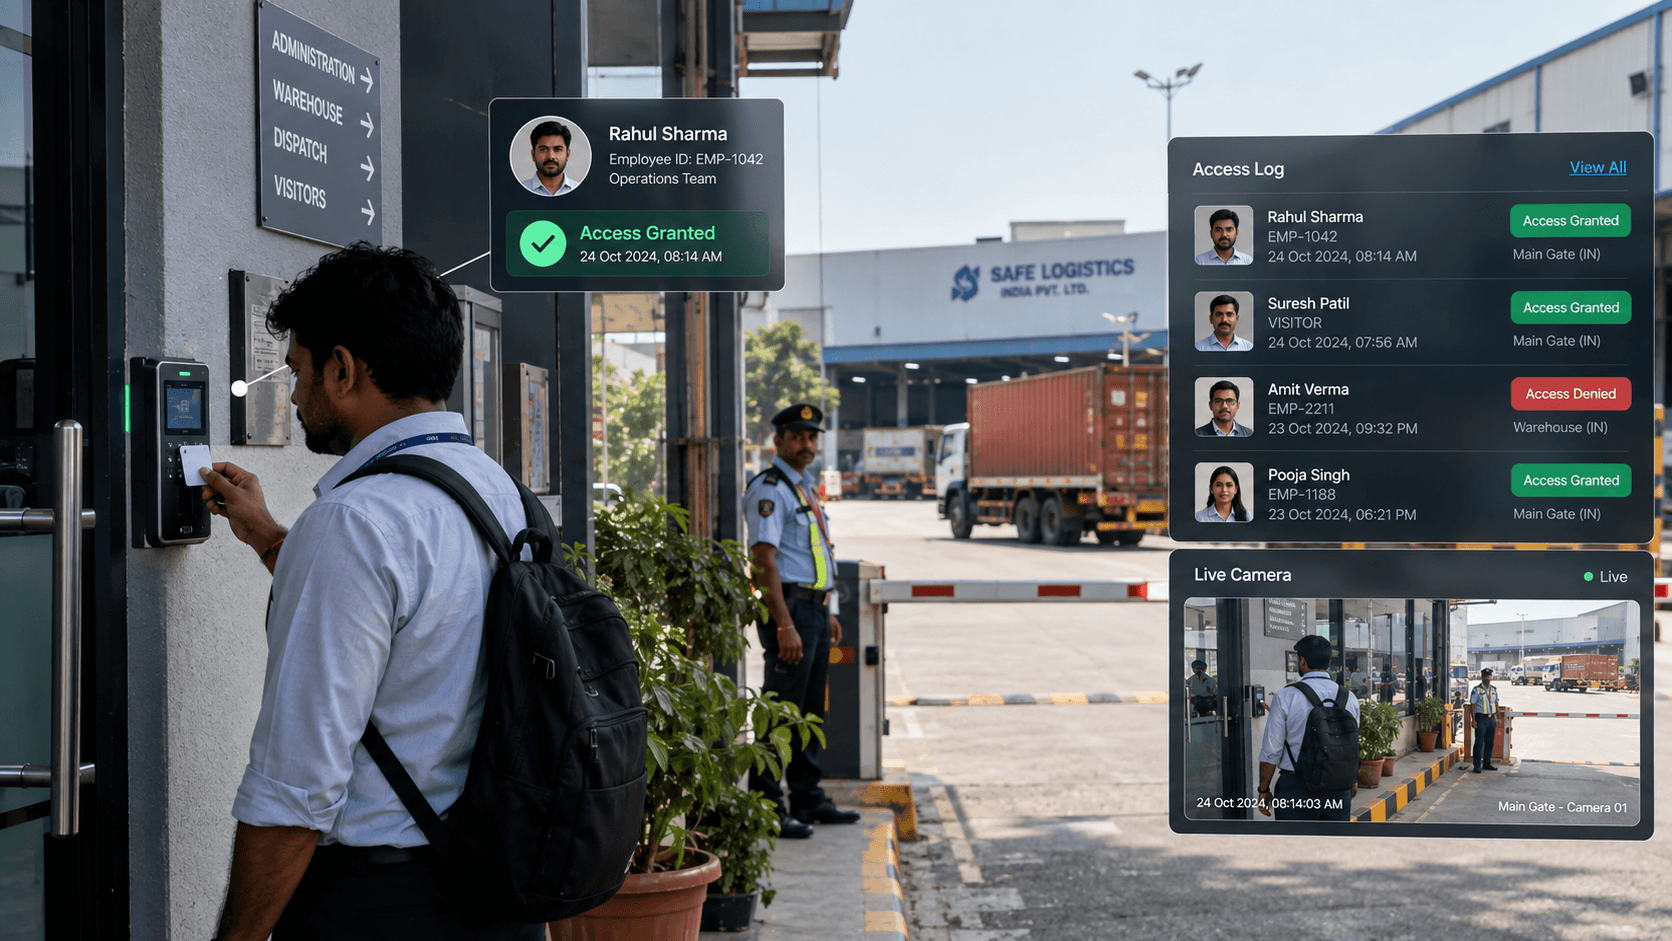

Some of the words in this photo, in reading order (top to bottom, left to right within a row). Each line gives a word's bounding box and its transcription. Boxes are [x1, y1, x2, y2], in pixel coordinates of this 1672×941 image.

[271, 29, 356, 85] ADMINISTRATION
[272, 79, 343, 126] WAREHOUSE
[273, 127, 328, 165] DISPATCH
[273, 174, 327, 209] VISITORS
[990, 263, 1036, 283] SAFE
[1041, 258, 1135, 280] LOGISTICS
[1000, 286, 1032, 298] INDIA
[1036, 284, 1061, 297] PVT.
[1064, 282, 1090, 296] LTD.
